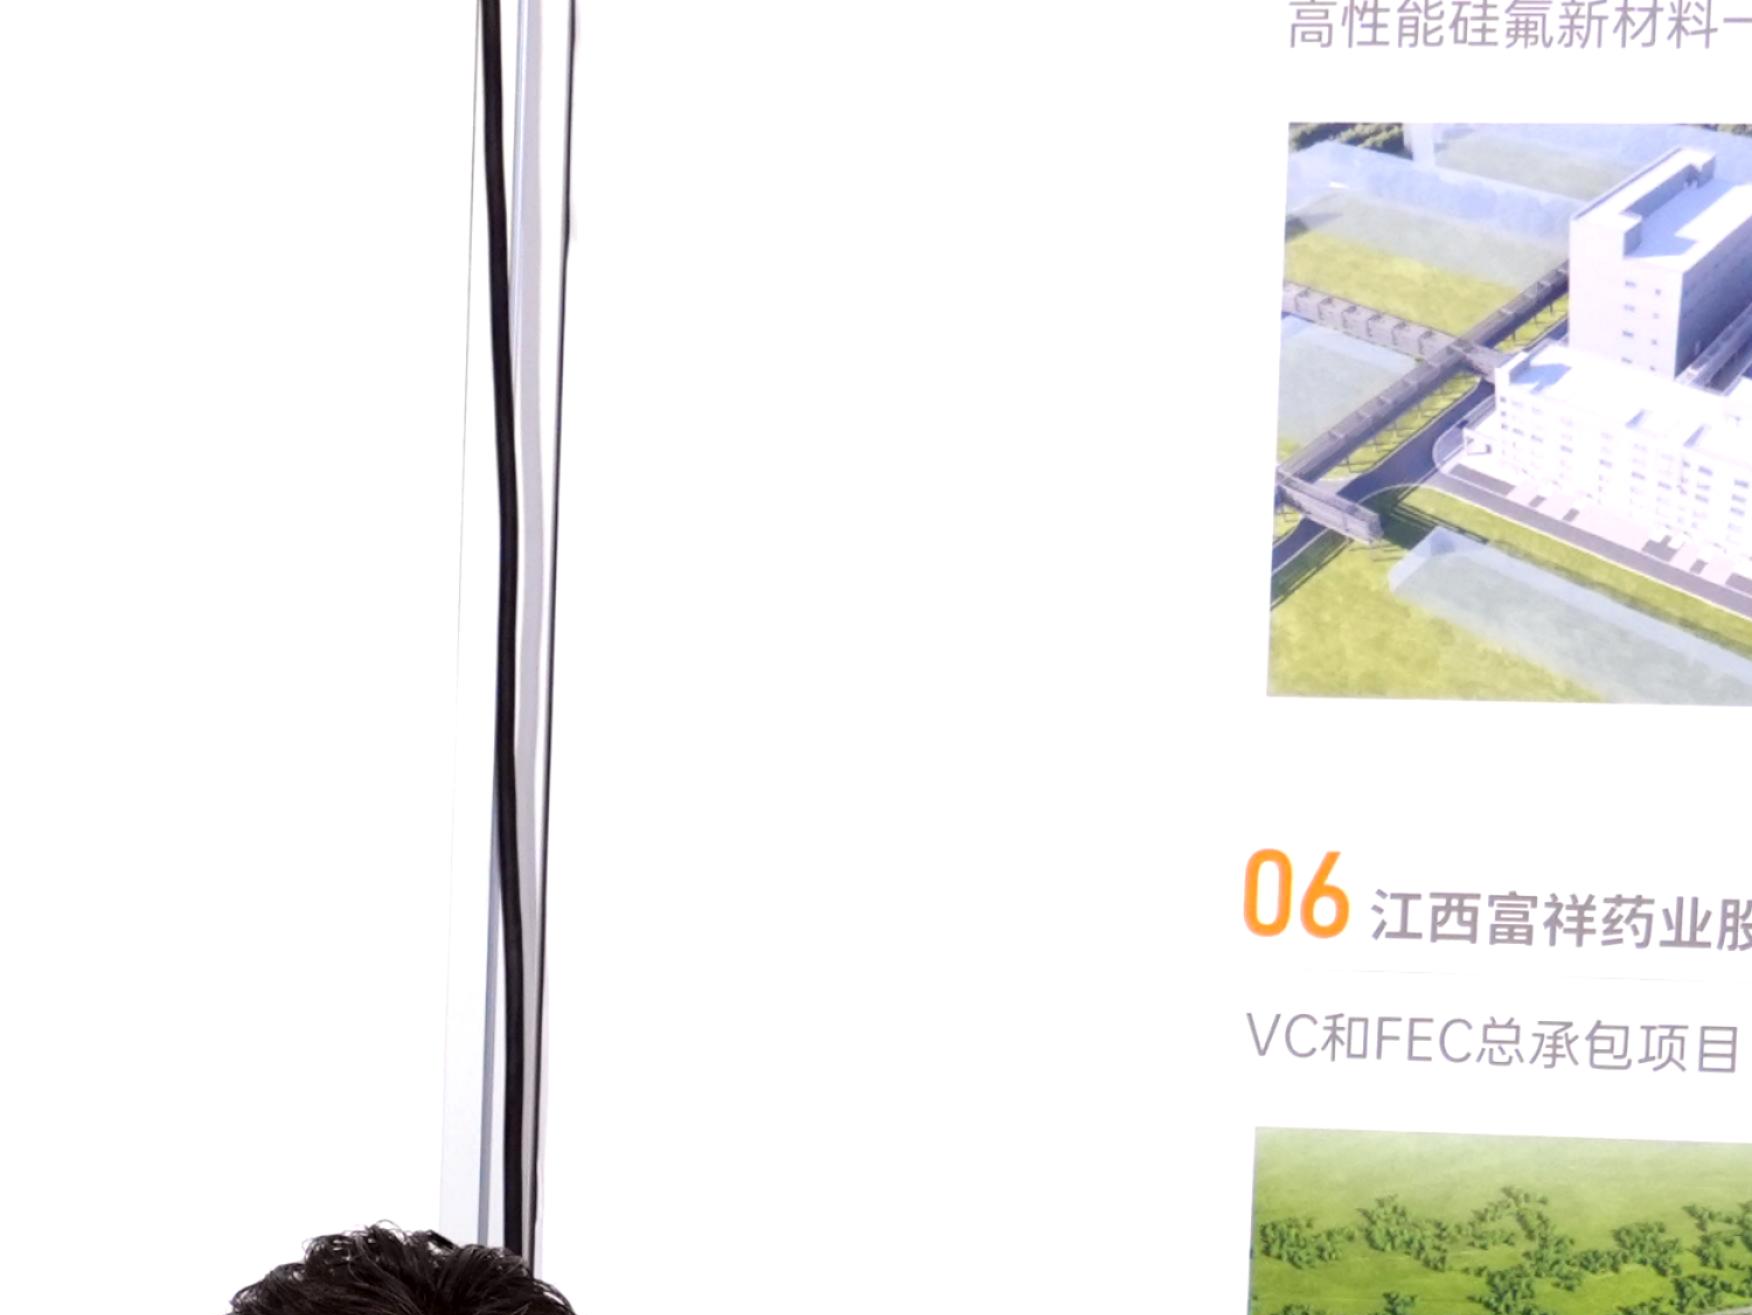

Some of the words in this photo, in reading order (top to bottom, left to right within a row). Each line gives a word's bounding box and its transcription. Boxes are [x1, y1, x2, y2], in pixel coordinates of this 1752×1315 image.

[1244, 849, 1351, 940] 06
[1247, 1013, 1739, 1075] VC和FEC总承包项目
